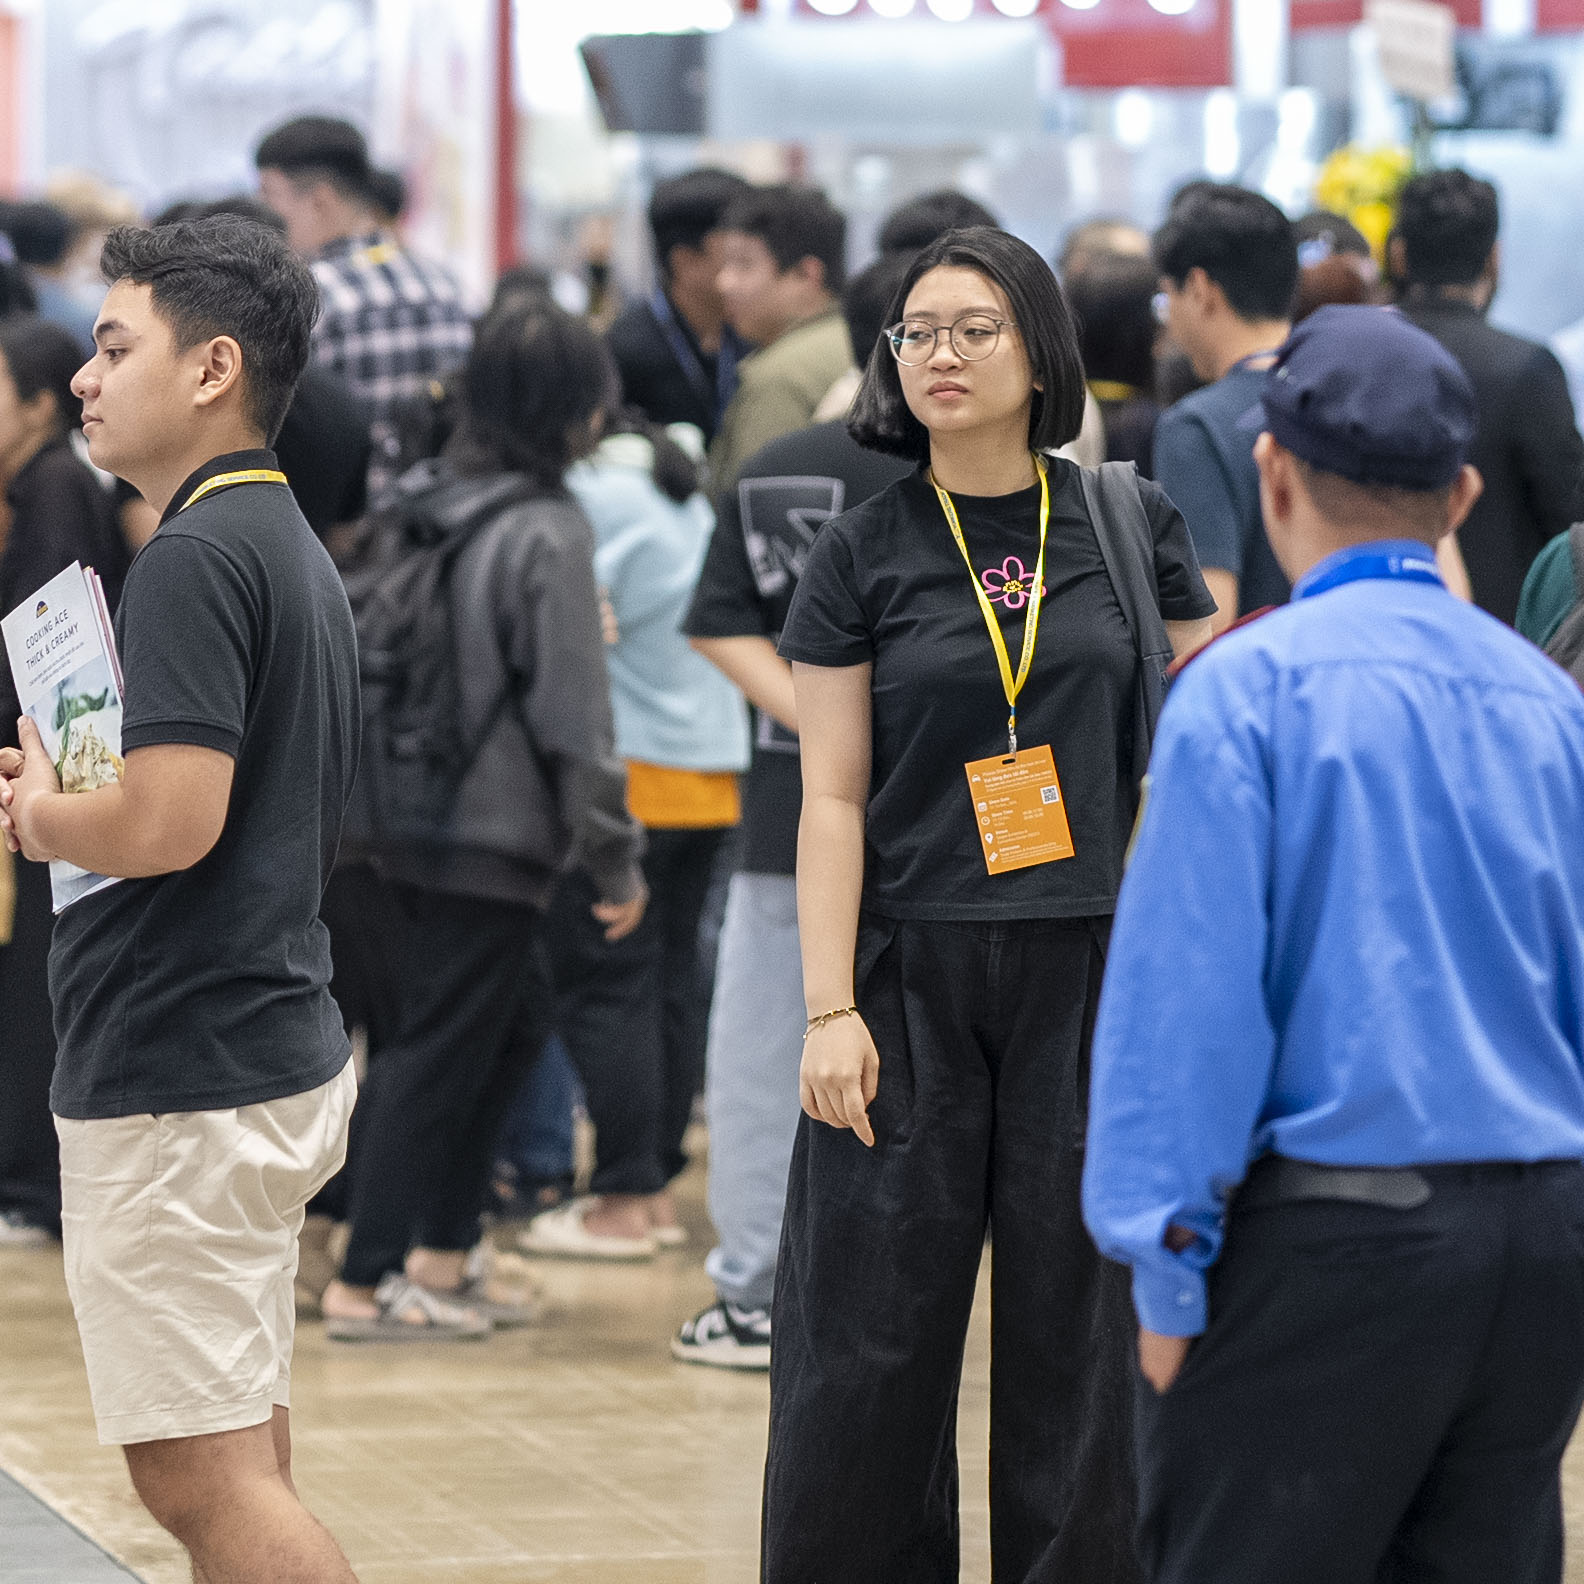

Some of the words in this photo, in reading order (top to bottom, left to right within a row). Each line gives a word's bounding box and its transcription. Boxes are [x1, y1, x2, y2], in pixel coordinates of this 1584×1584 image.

[25, 620, 53, 649] COOKING
[55, 608, 69, 628] ACE
[25, 651, 44, 671] THICK
[45, 644, 50, 655] &
[50, 622, 79, 650] CREAMY
